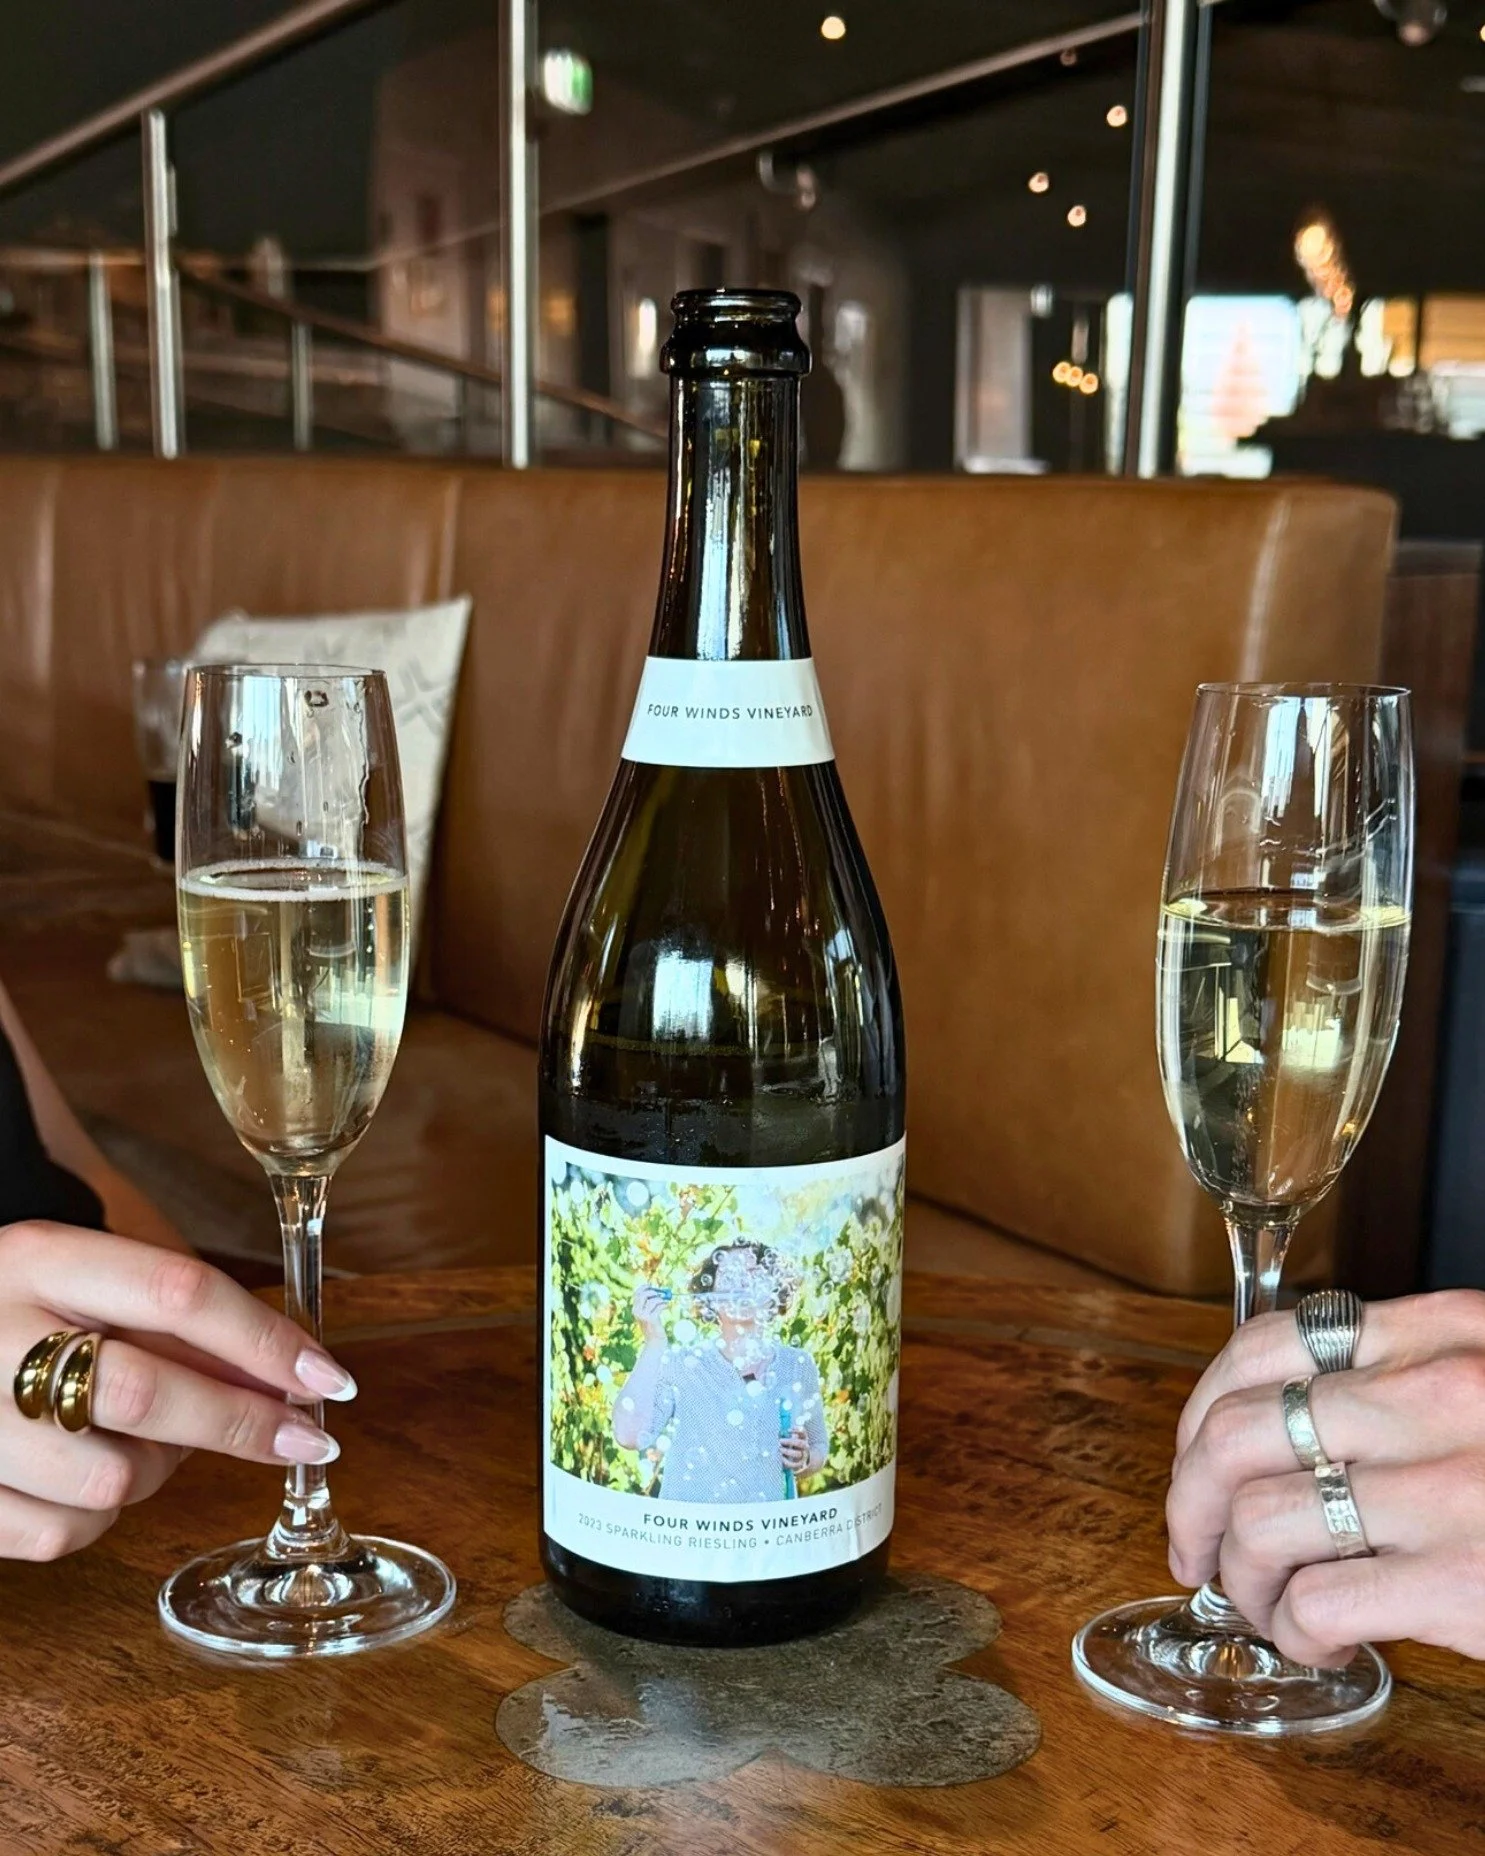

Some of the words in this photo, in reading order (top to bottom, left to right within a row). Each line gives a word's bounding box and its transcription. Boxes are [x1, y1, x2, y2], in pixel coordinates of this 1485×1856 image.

[647, 703, 678, 718] FOUR
[685, 706, 740, 720] WINDS
[747, 704, 813, 719] VINEYARD
[578, 1513, 602, 1531] 2023
[606, 1523, 682, 1547] SPARKLING
[688, 1536, 757, 1550] RIESLING
[776, 1524, 843, 1546] CANBERRA
[643, 1513, 688, 1530] FOUR
[696, 1520, 754, 1532] WINDS
[762, 1507, 838, 1530] VINEYARD
